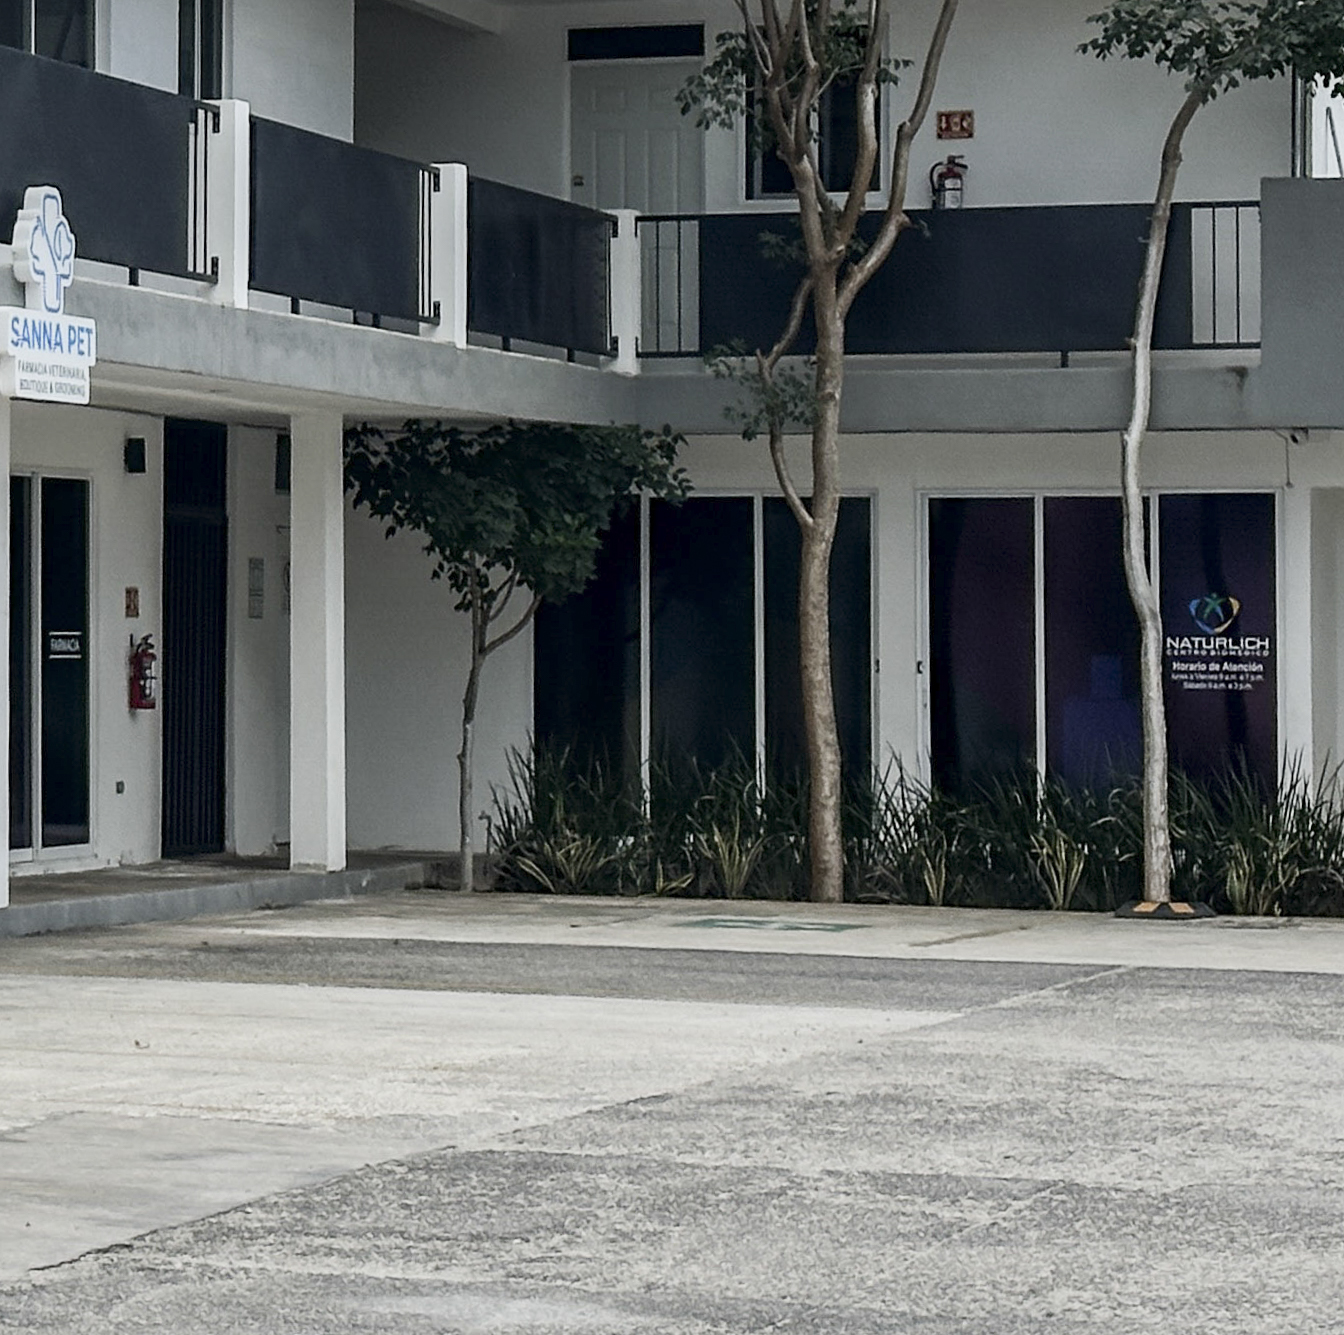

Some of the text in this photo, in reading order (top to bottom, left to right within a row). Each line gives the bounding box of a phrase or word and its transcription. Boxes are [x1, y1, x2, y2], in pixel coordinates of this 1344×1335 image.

[11, 316, 93, 357] SANNA PET
[1166, 636, 1269, 650] NATURLICH
[1166, 649, 1207, 657] CENTRO
[1173, 661, 1264, 672] Horario de Atención
